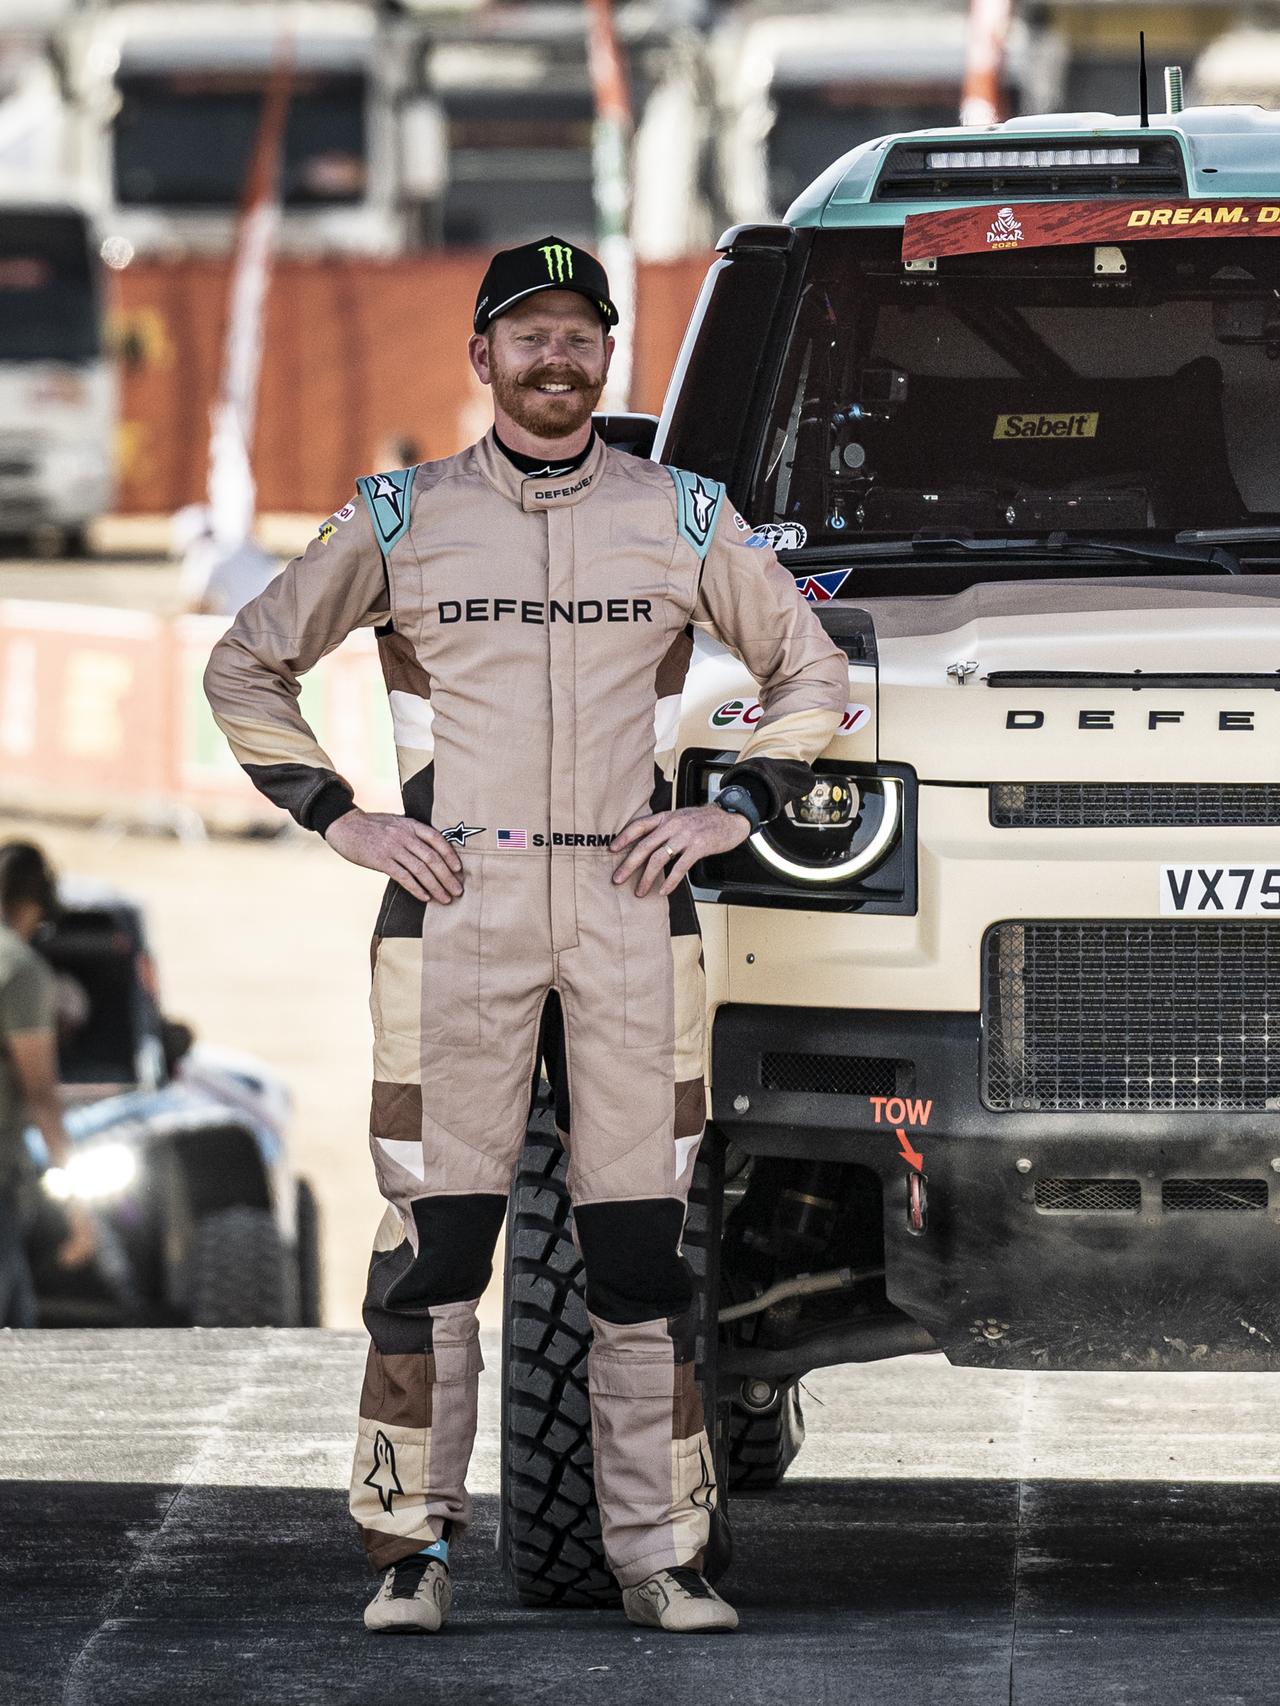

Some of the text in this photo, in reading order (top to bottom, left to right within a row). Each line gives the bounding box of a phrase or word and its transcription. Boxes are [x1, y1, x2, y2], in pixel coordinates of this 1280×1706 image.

[1127, 207, 1250, 227] DREAM.
[986, 231, 1024, 243] DAKAR
[991, 241, 1018, 249] 2026
[1004, 416, 1088, 437] Sabelt
[438, 598, 653, 625] DEFENDER
[869, 1096, 933, 1126] TOW
